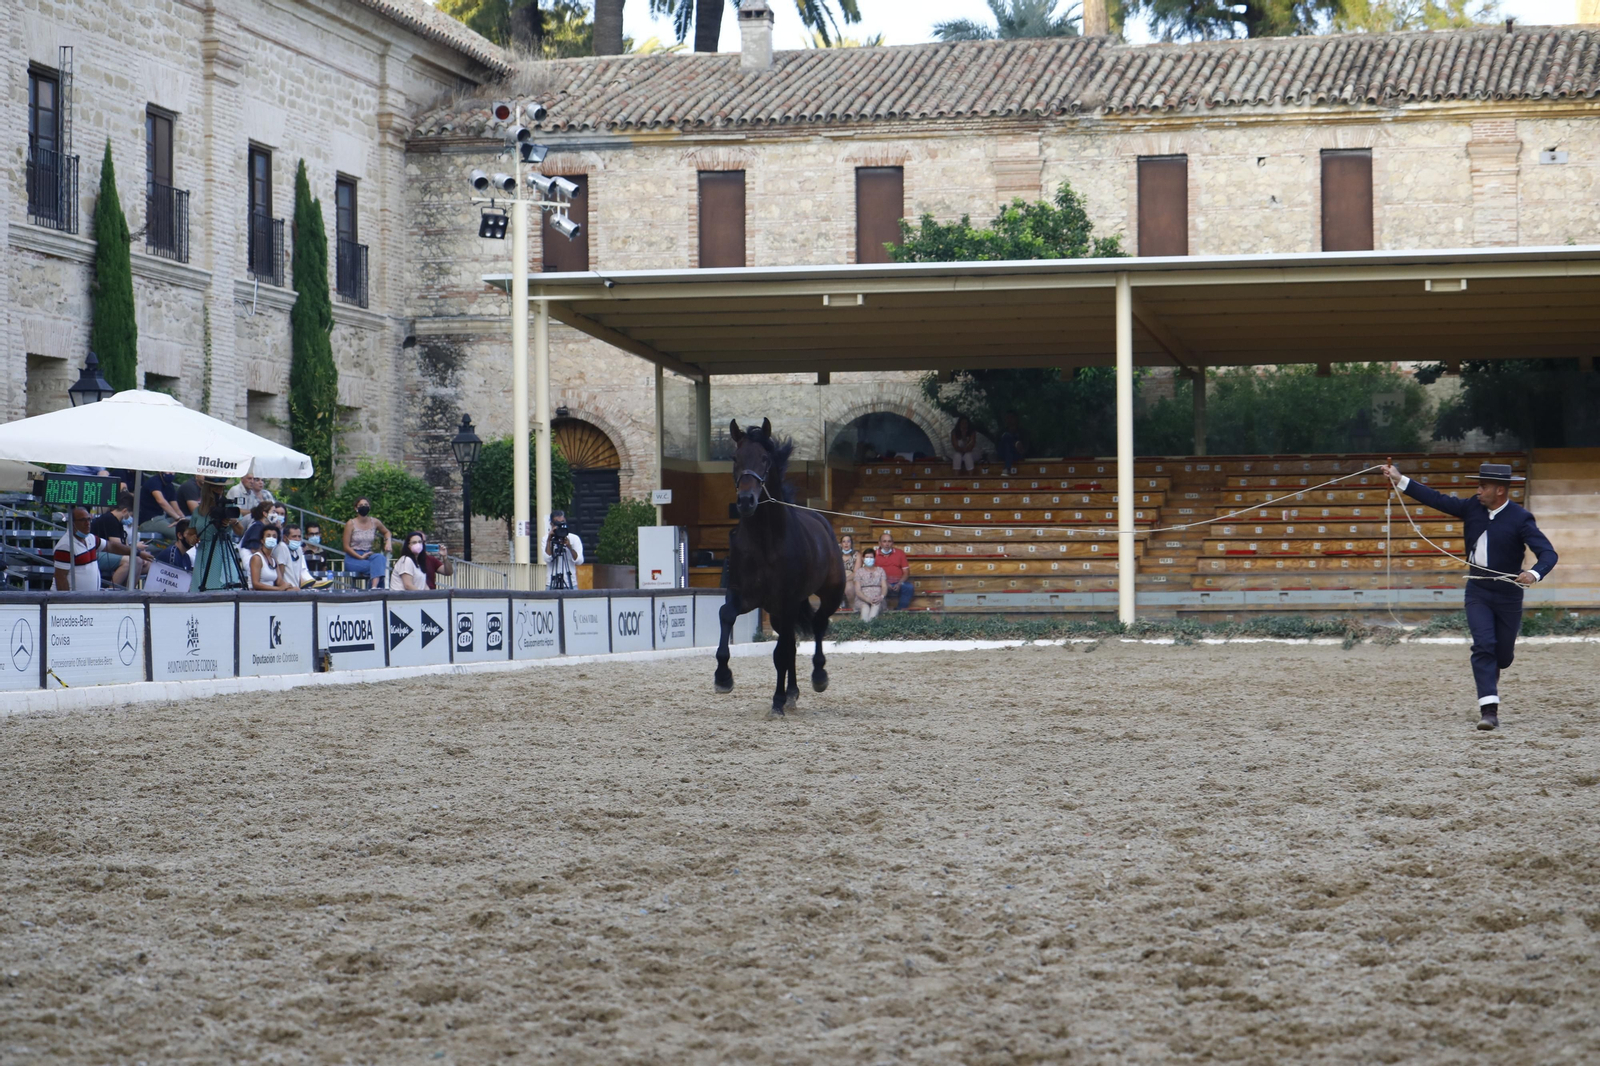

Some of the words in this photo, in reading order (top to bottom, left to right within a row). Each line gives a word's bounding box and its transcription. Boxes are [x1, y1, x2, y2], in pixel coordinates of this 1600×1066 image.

[198, 456, 237, 470] Mahou
[83, 482, 102, 505] BAT
[160, 569, 178, 579] GRADA
[156, 577, 178, 588] LATERAL
[51, 615, 93, 627] Mercedes-Benz
[532, 611, 554, 634] TONO
[329, 615, 373, 642] CÓRDOBA
[51, 634, 70, 646] Covisa
[76, 658, 86, 667] Oficial
[253, 653, 275, 666] Diputación
[276, 653, 281, 663] de
[167, 660, 194, 673] AYUNTAMIENTO
[195, 660, 200, 671] DE
